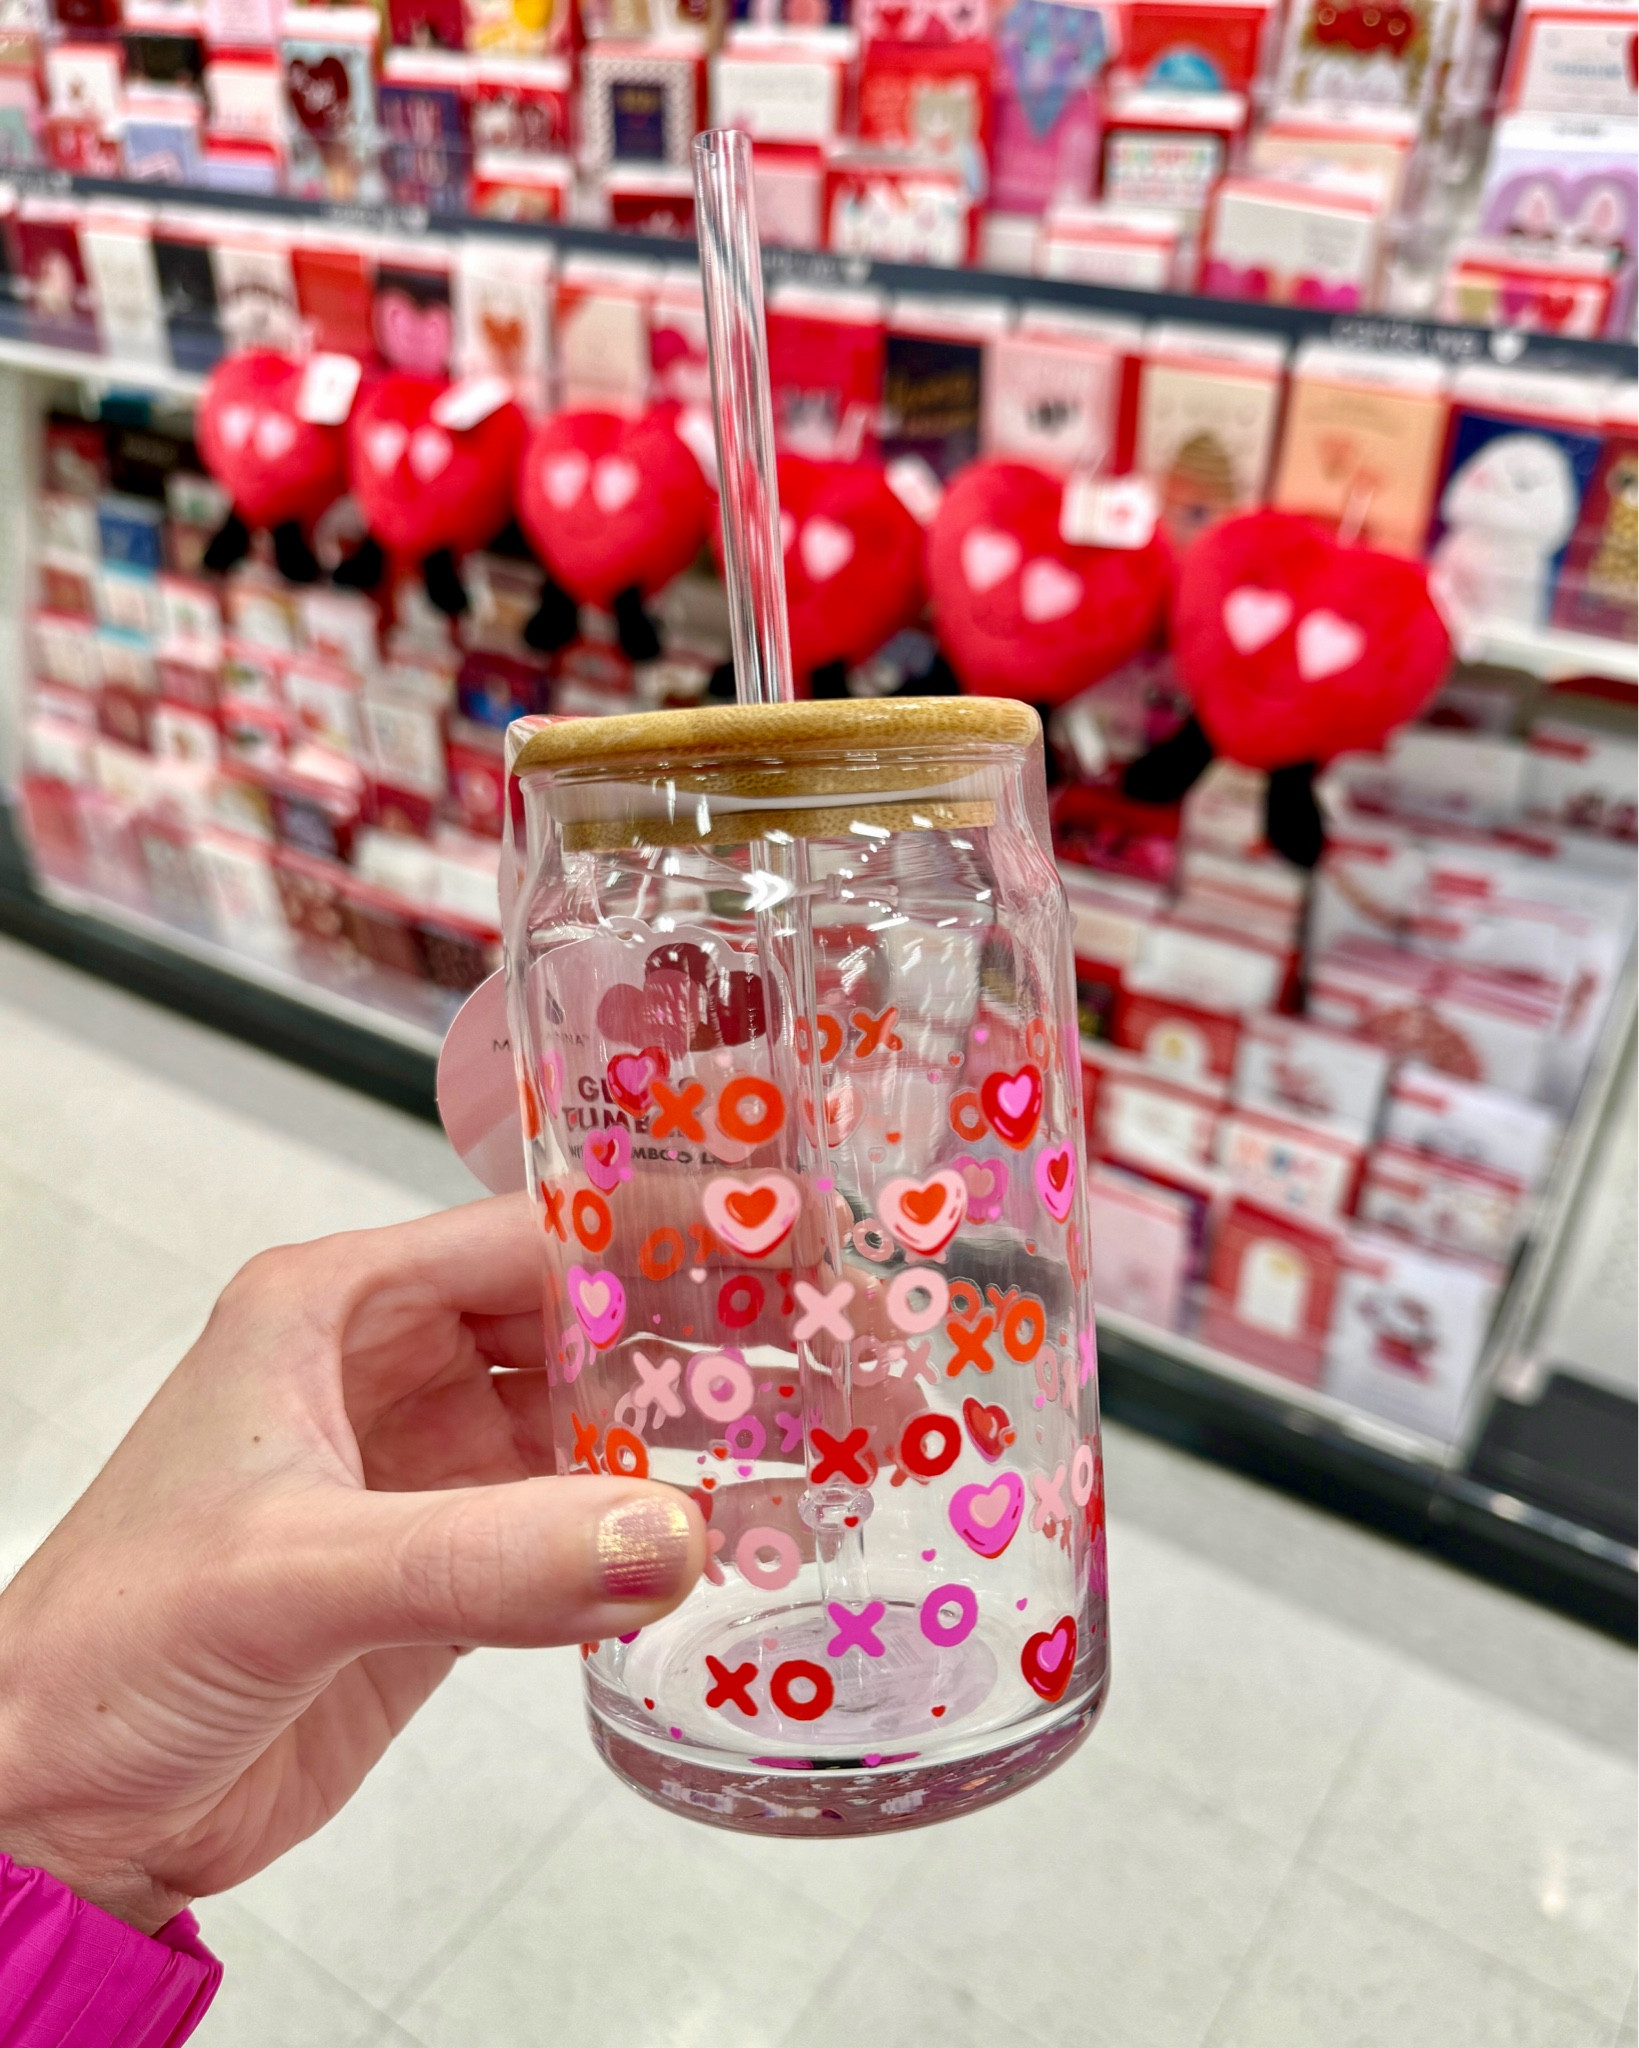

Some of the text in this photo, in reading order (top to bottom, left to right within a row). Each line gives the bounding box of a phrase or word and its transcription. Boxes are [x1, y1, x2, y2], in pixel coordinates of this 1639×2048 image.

[650, 1076, 786, 1145] XO
[541, 1181, 613, 1251] XO
[793, 1267, 949, 1341] XO
[946, 1298, 1046, 1378] XO
[633, 1351, 755, 1423] XO
[571, 1412, 649, 1480] XO
[810, 1413, 962, 1485] XO
[827, 1583, 978, 1657] XO
[705, 1655, 834, 1721] XO
